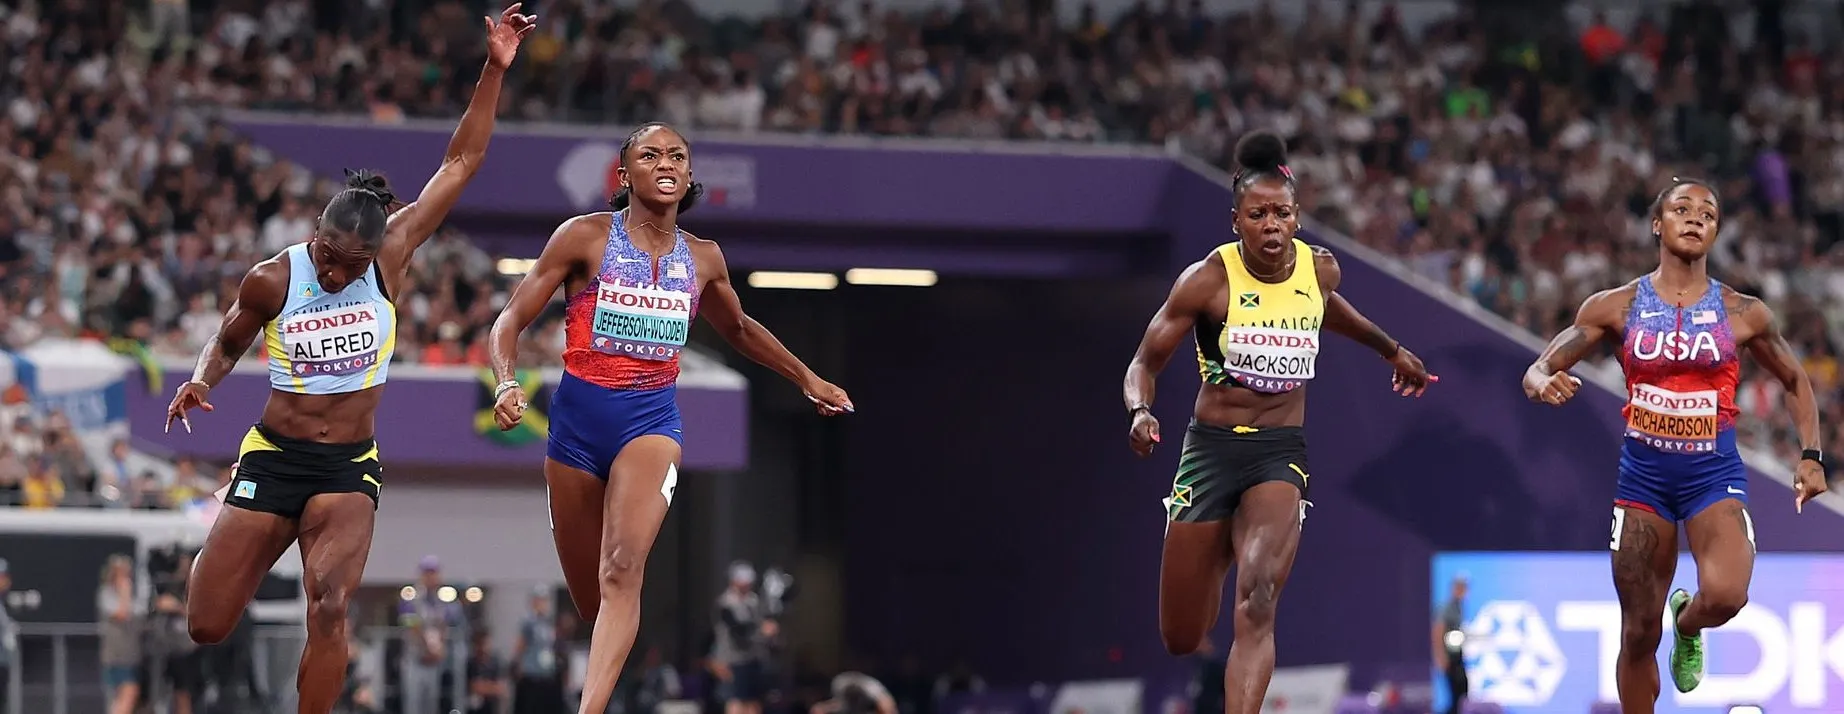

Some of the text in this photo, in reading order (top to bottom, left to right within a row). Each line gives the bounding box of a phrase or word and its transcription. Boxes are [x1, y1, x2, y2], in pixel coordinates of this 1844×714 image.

[599, 288, 688, 312] HONDA
[286, 310, 375, 334] HONDA
[596, 311, 687, 342] JEFFERSON-WOODEN
[294, 331, 374, 359] ALFRED
[614, 342, 679, 357] TOKYO2
[1231, 332, 1317, 349] HONDA
[1633, 330, 1721, 362] USA
[1230, 353, 1311, 375] JACKSON
[1634, 387, 1714, 410] HONDA
[1632, 409, 1713, 437] RICHARDSON
